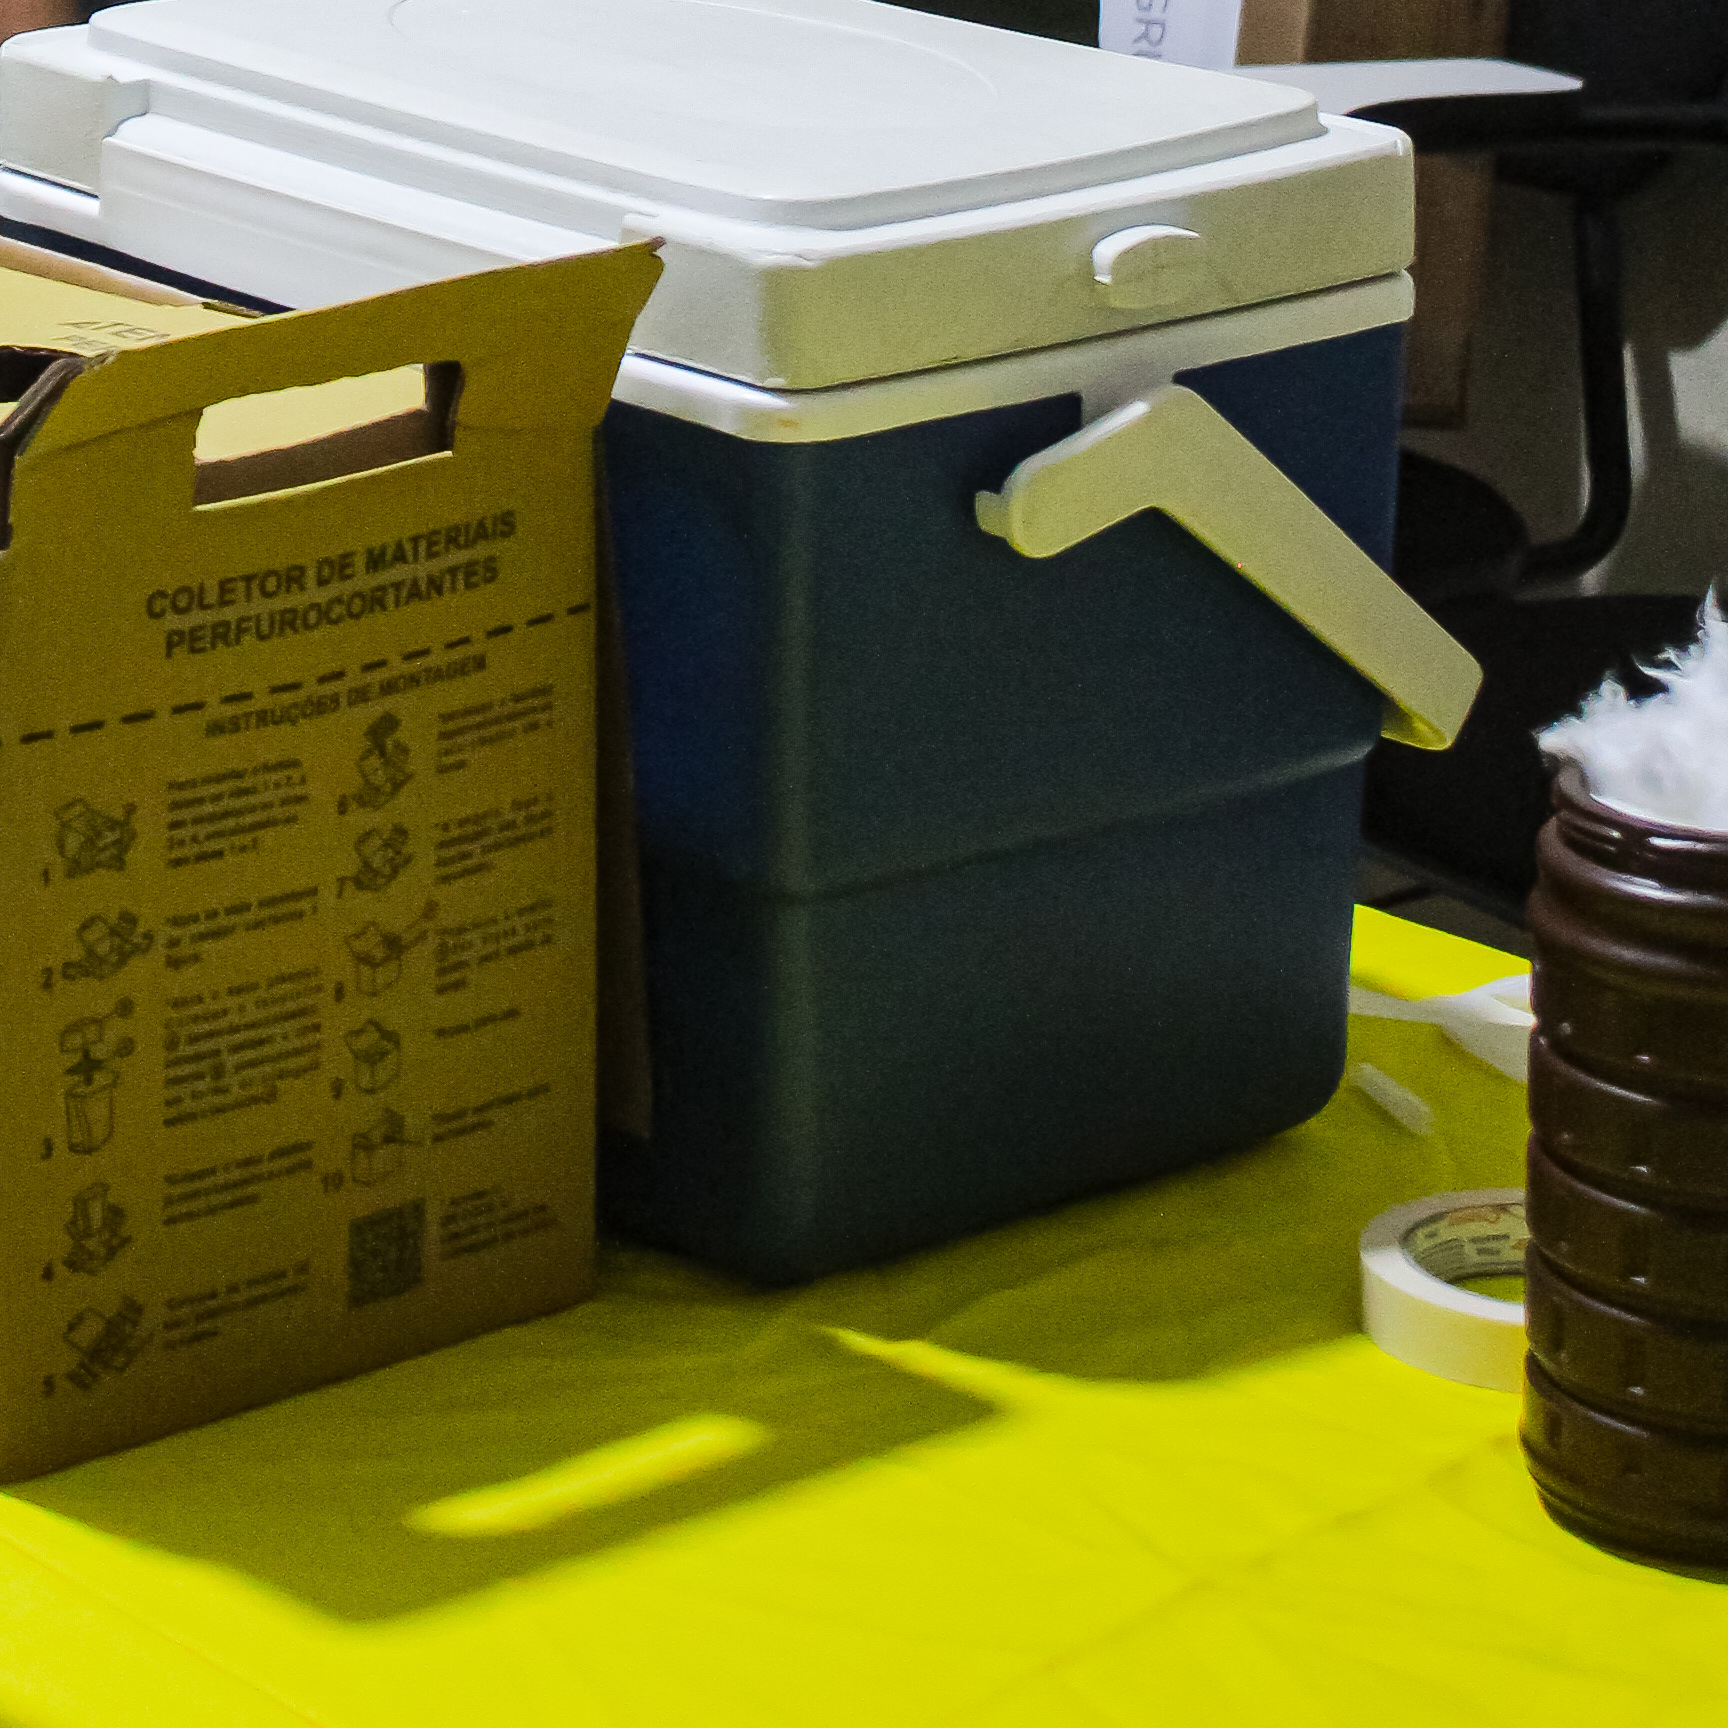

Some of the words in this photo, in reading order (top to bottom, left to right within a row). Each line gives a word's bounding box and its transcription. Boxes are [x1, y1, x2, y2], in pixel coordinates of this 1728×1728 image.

[146, 564, 305, 619] COLETOR
[316, 551, 356, 587] DE
[364, 510, 517, 574] MATERIAIS
[165, 556, 499, 658] PERFUROCORTANTES
[205, 691, 341, 737] INSTRUÇÕES
[347, 682, 371, 706] DE
[378, 653, 486, 697] MONTAGEM
